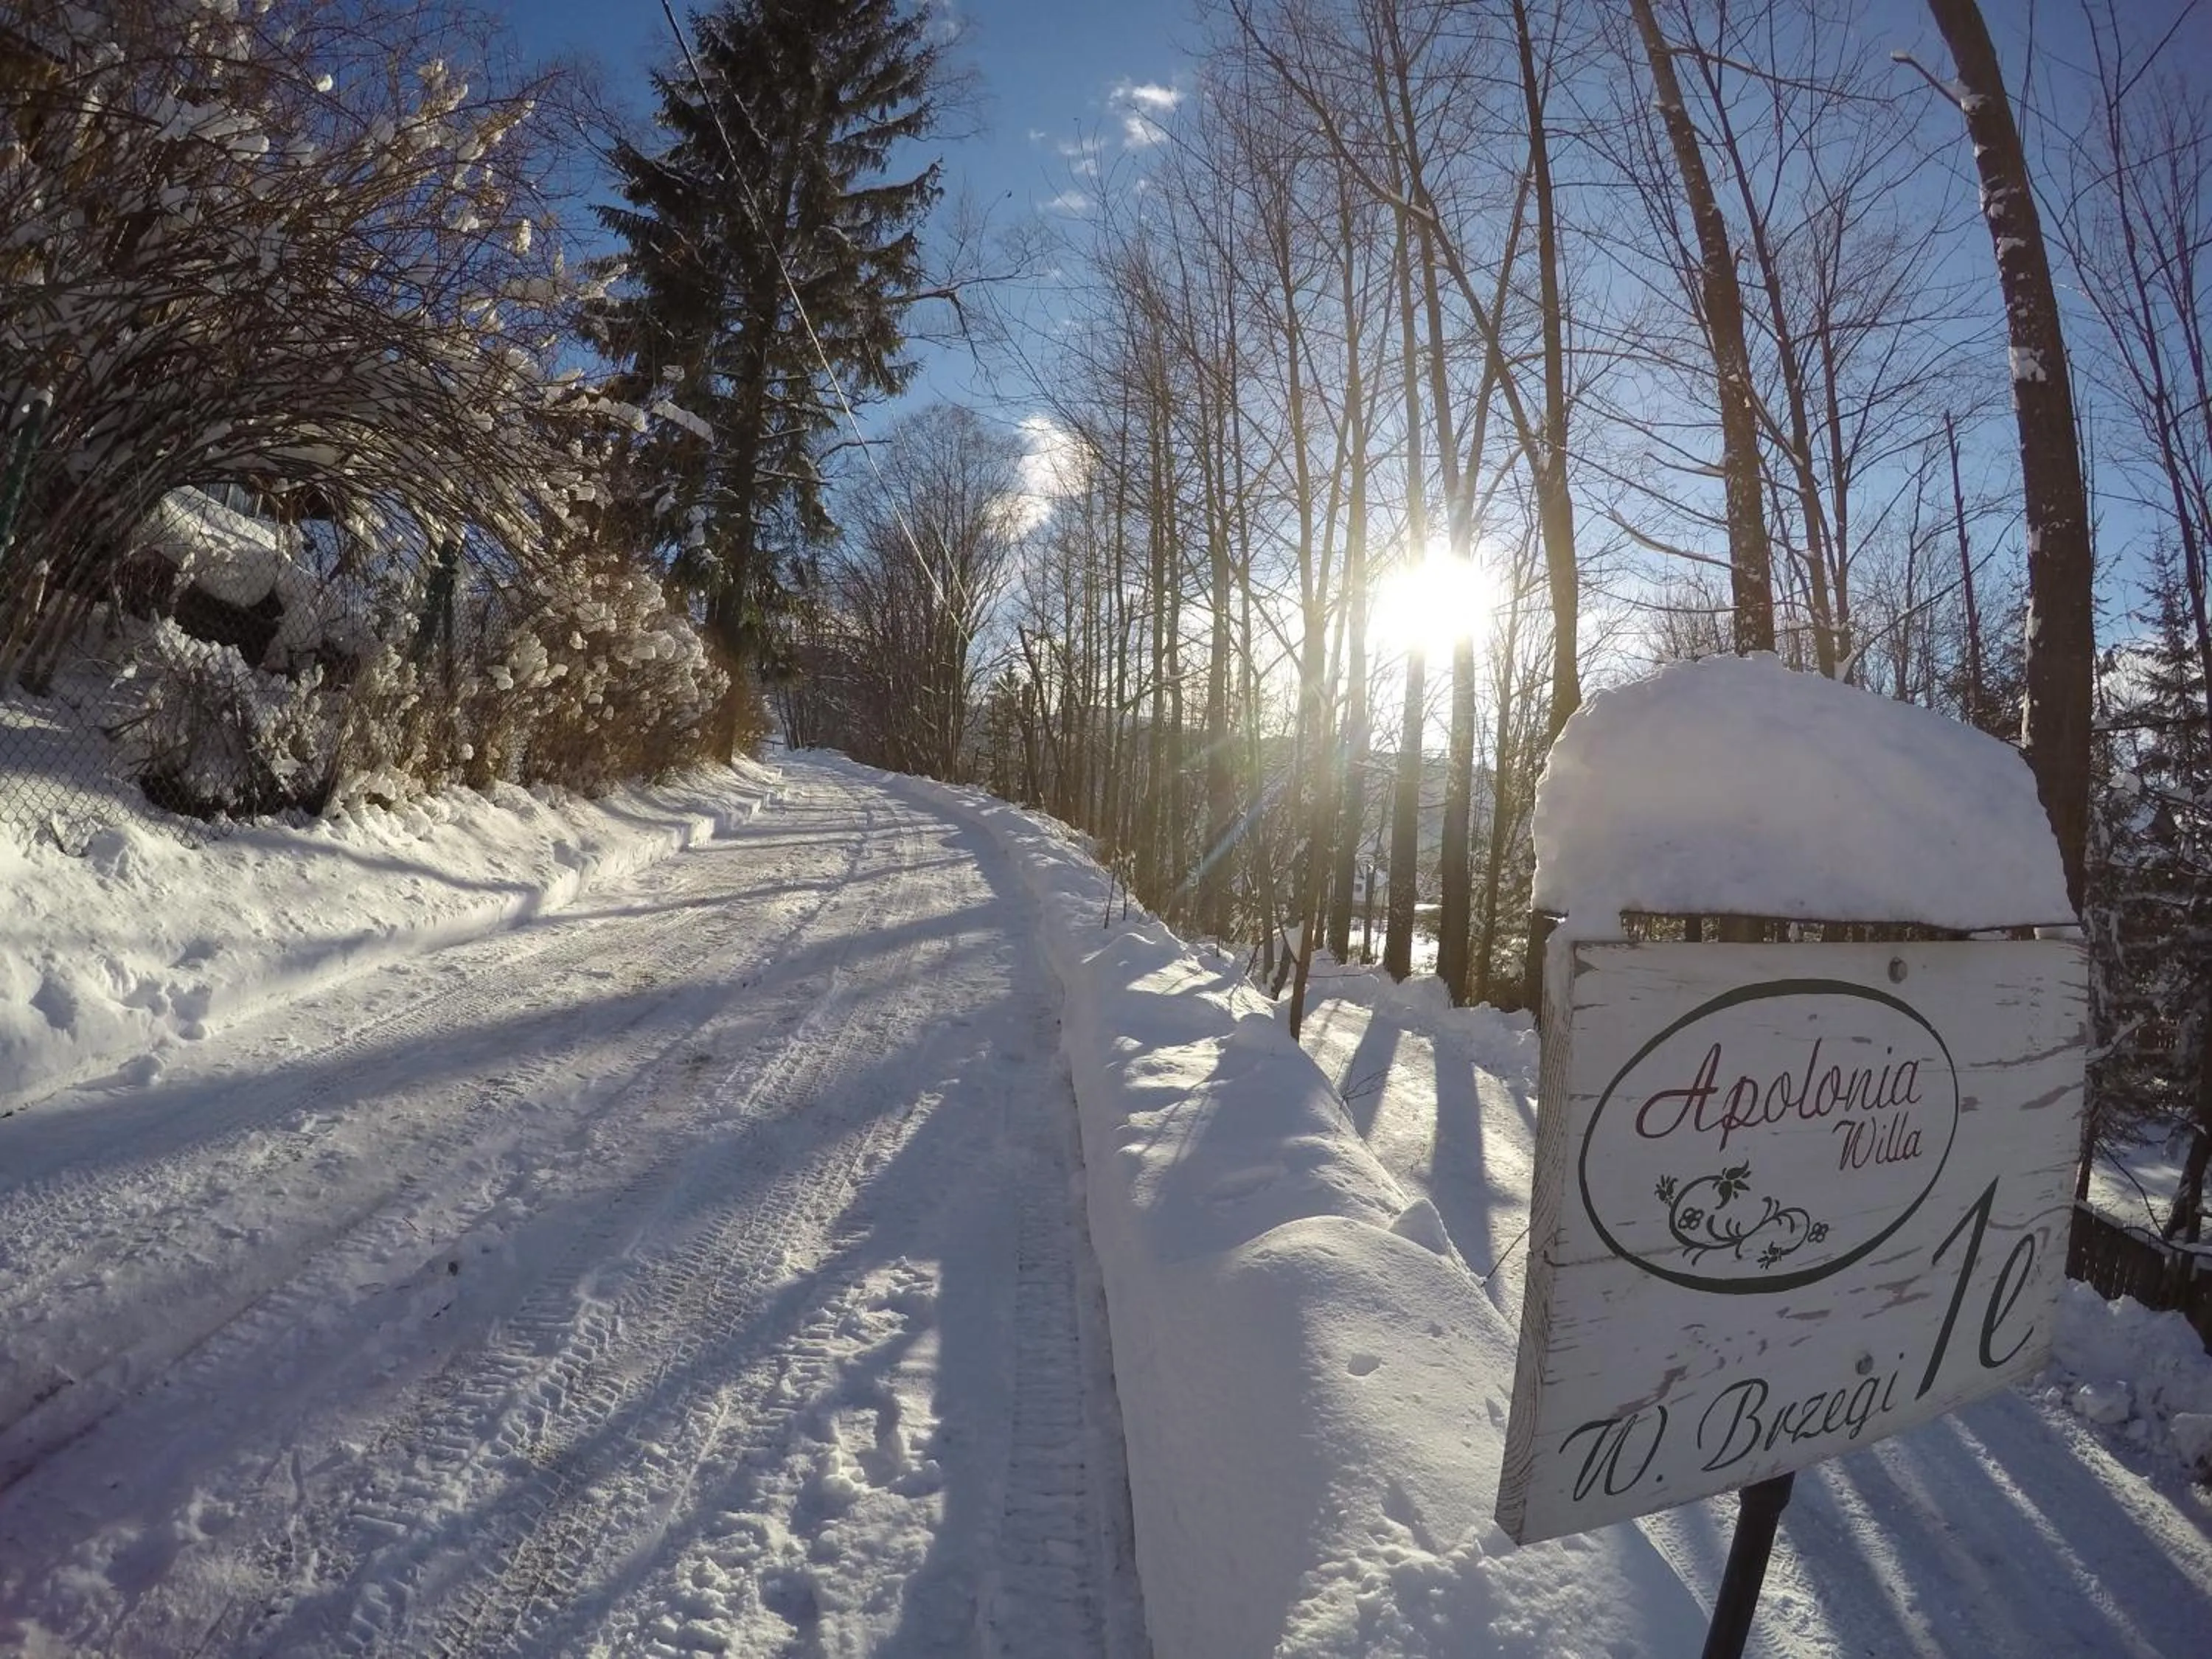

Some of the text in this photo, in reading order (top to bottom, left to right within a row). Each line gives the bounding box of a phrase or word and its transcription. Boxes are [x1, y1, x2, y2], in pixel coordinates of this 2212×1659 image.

[1635, 1038, 1922, 1151] Apolonia
[1832, 1112, 1922, 1171] Willa
[1558, 1405, 1668, 1502] W.
[1697, 1352, 1905, 1472] Brzegi
